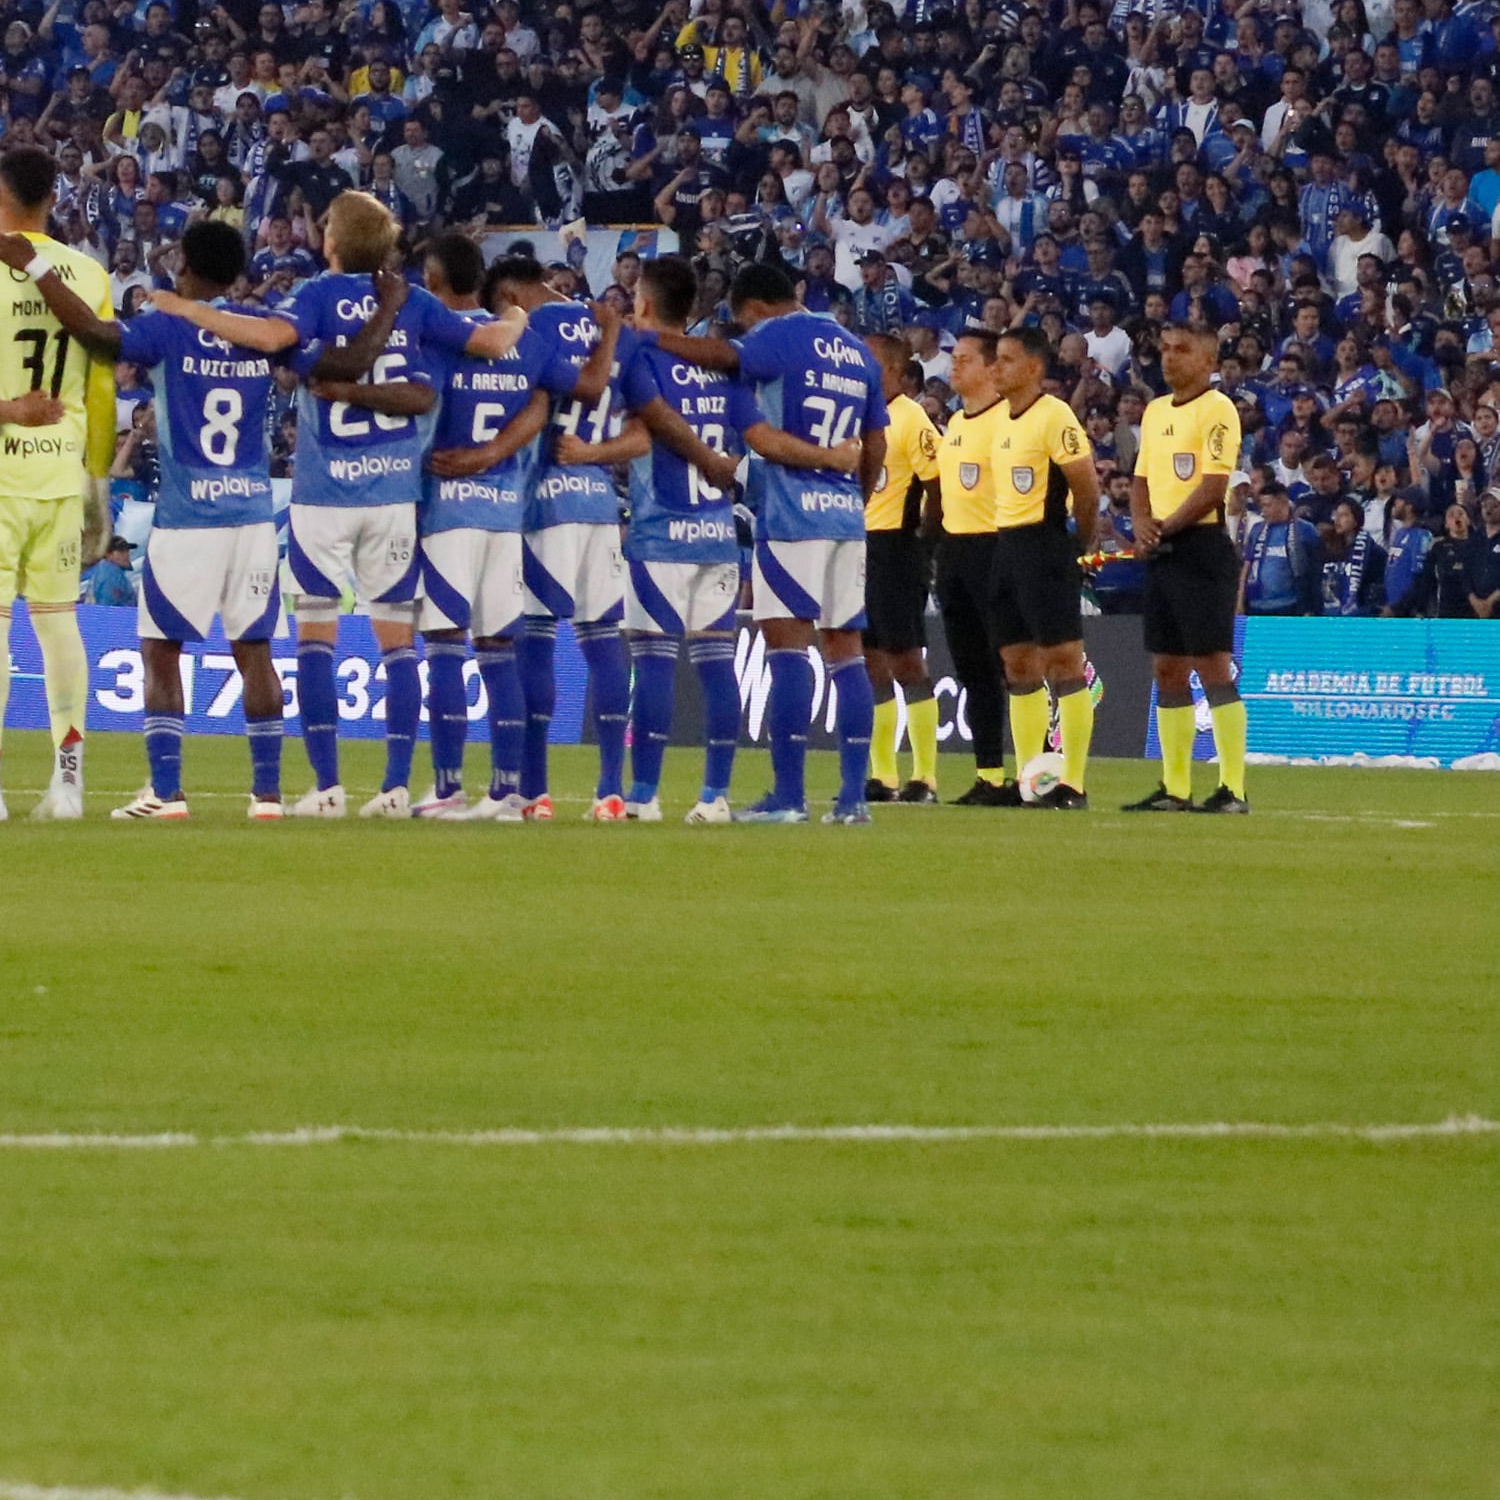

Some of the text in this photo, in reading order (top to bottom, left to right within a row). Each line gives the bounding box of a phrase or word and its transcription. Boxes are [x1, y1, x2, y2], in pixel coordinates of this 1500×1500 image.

[13, 329, 72, 401] 31
[471, 373, 528, 393] AREVALO
[805, 369, 819, 389] S.
[198, 386, 243, 466] 8
[329, 456, 411, 482] Wplay.co
[439, 482, 517, 506] Wplay.co
[1265, 672, 1488, 697] ACADEMIA DE FUTBOL
